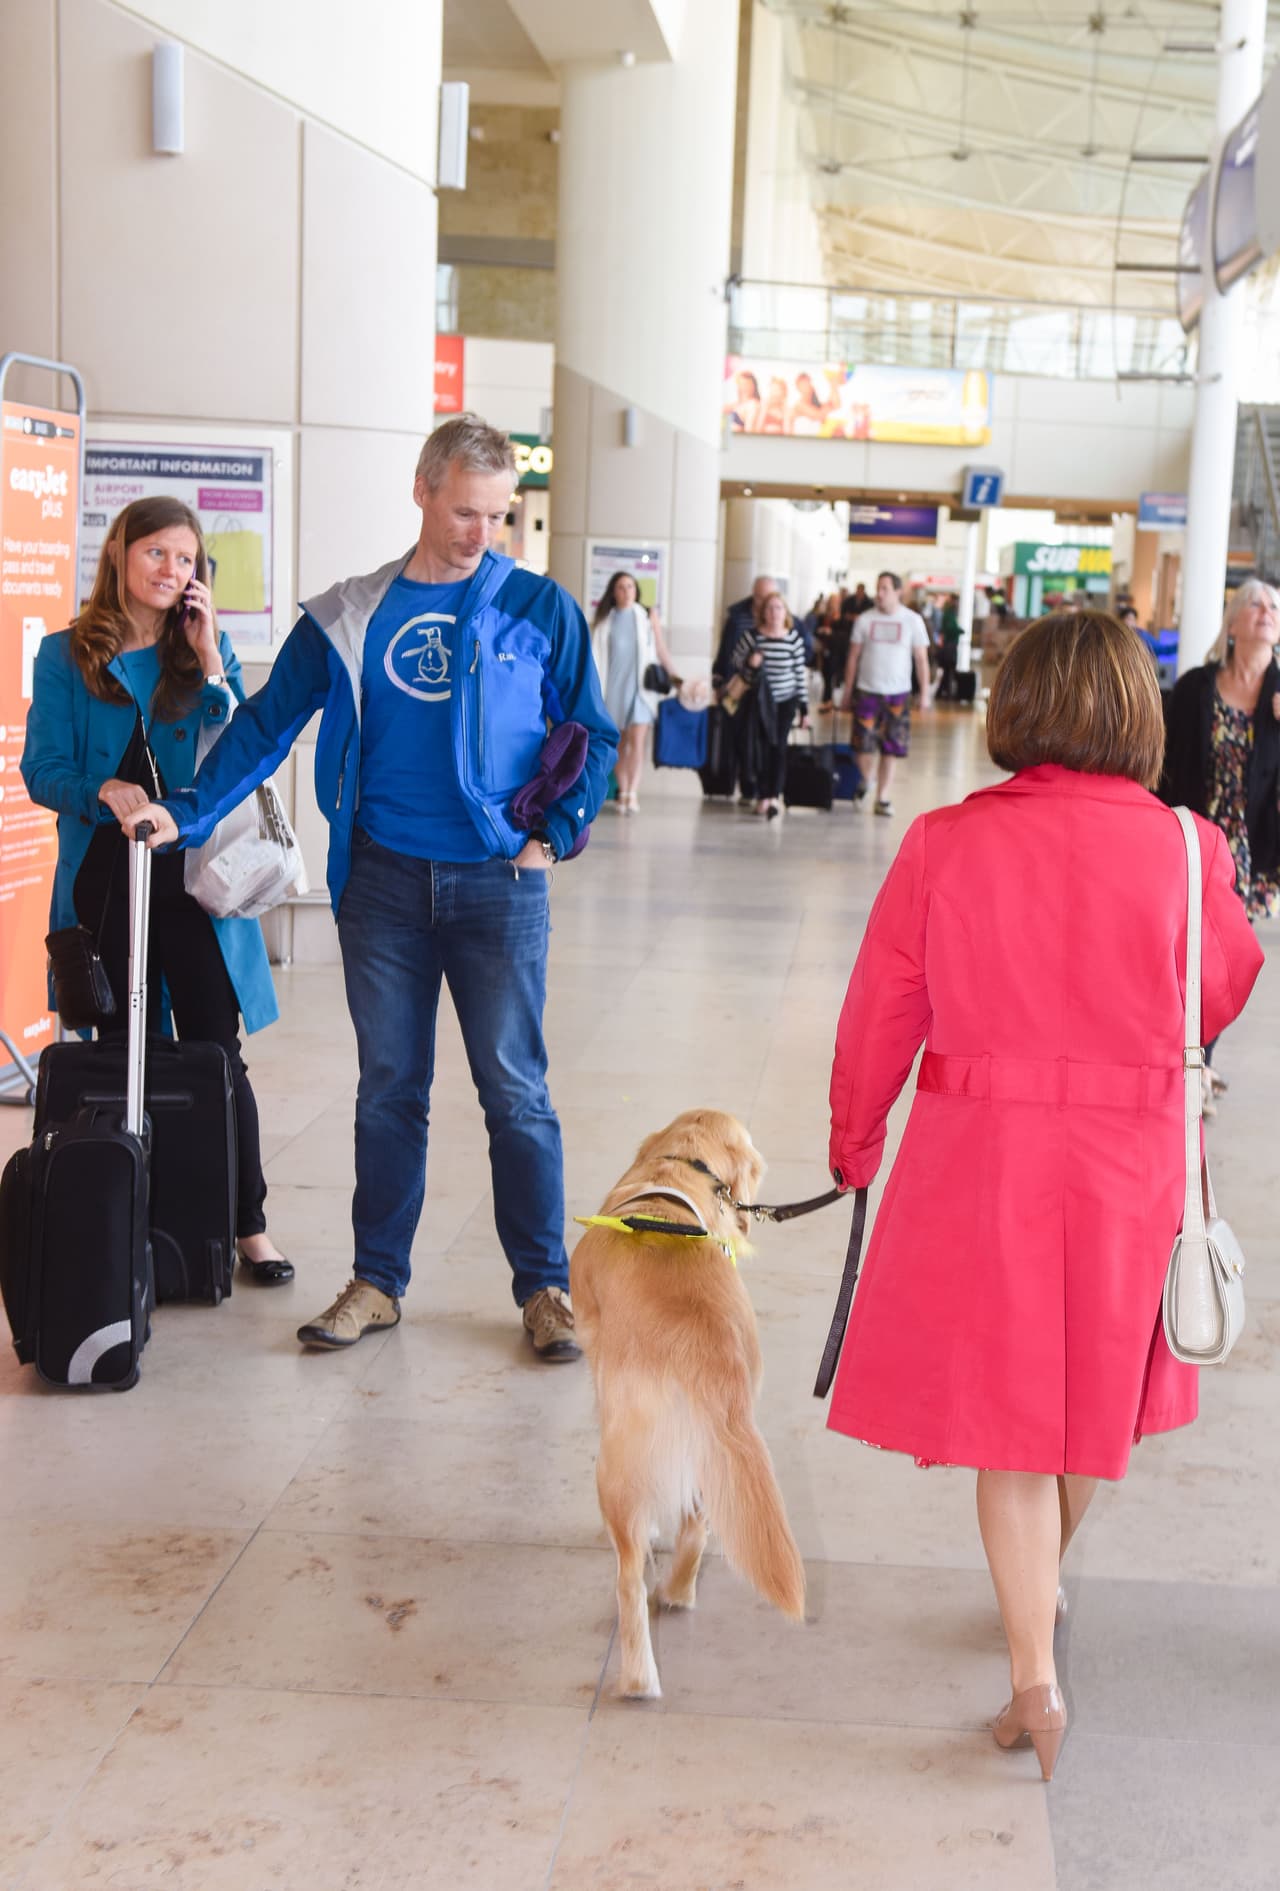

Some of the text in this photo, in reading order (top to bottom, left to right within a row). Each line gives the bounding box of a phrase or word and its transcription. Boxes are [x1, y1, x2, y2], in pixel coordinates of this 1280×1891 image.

[86, 456, 254, 476] IMPORTANT INFORMATION
[9, 465, 68, 500] easyJet
[94, 483, 145, 496] AIRPORT
[42, 497, 63, 520] plus
